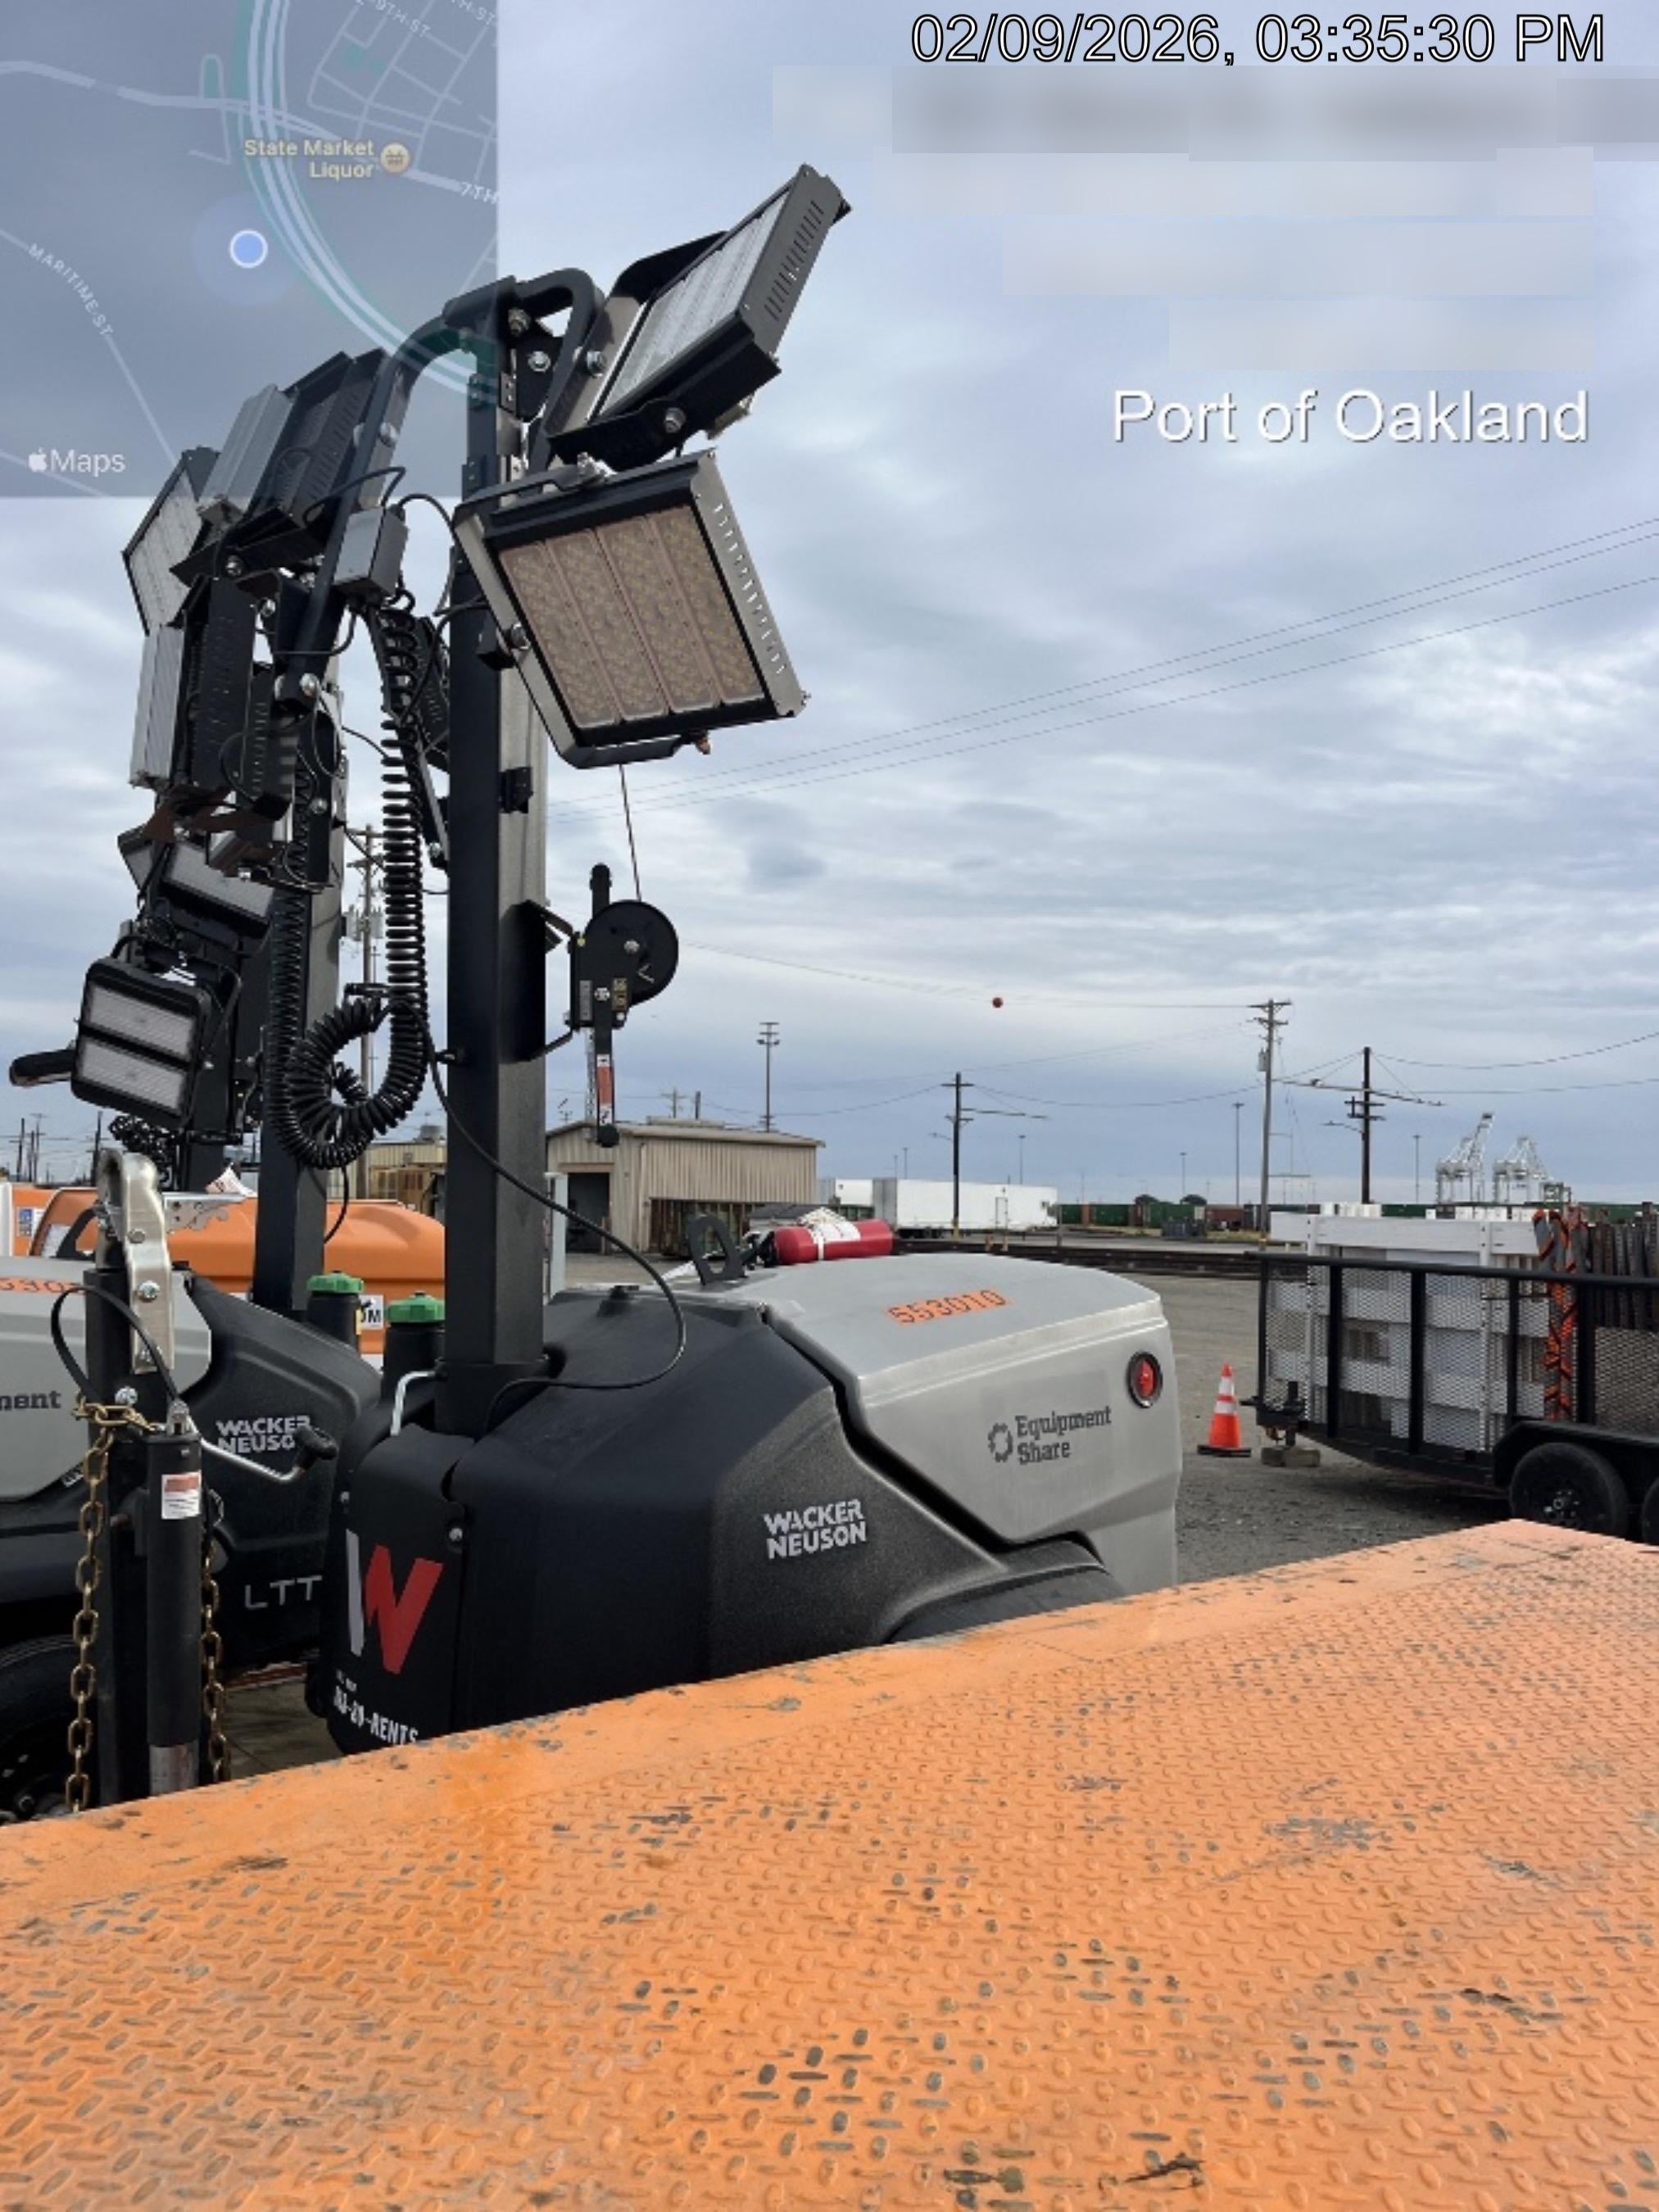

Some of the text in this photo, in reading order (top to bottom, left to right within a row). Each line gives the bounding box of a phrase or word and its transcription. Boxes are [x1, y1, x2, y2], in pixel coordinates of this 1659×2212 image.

[215, 1415, 310, 1436] WACKER
[1015, 1405, 1112, 1440] Equipment
[217, 1434, 297, 1453] NEUSO
[1017, 1441, 1071, 1465] Share
[763, 1498, 865, 1535] WACKER
[767, 1521, 867, 1559] NEUSON
[245, 1575, 323, 1611] LTT
